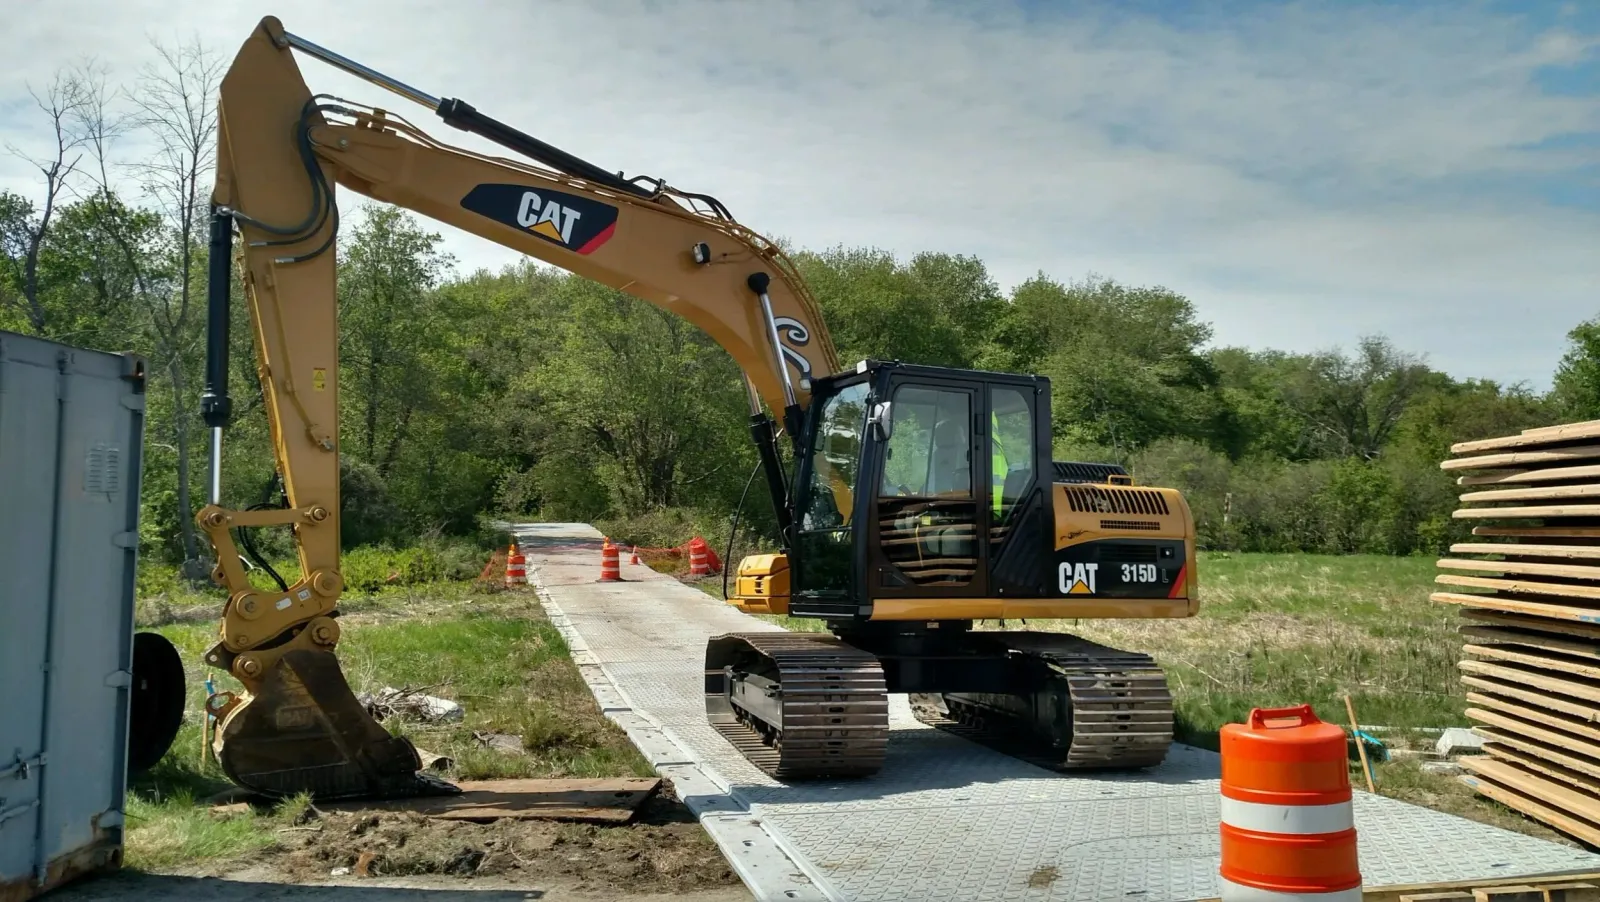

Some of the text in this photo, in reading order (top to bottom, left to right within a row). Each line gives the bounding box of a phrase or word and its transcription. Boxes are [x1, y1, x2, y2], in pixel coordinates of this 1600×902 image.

[516, 191, 581, 245] CAT
[1058, 561, 1099, 594] CAT
[1121, 563, 1157, 583] 315D
